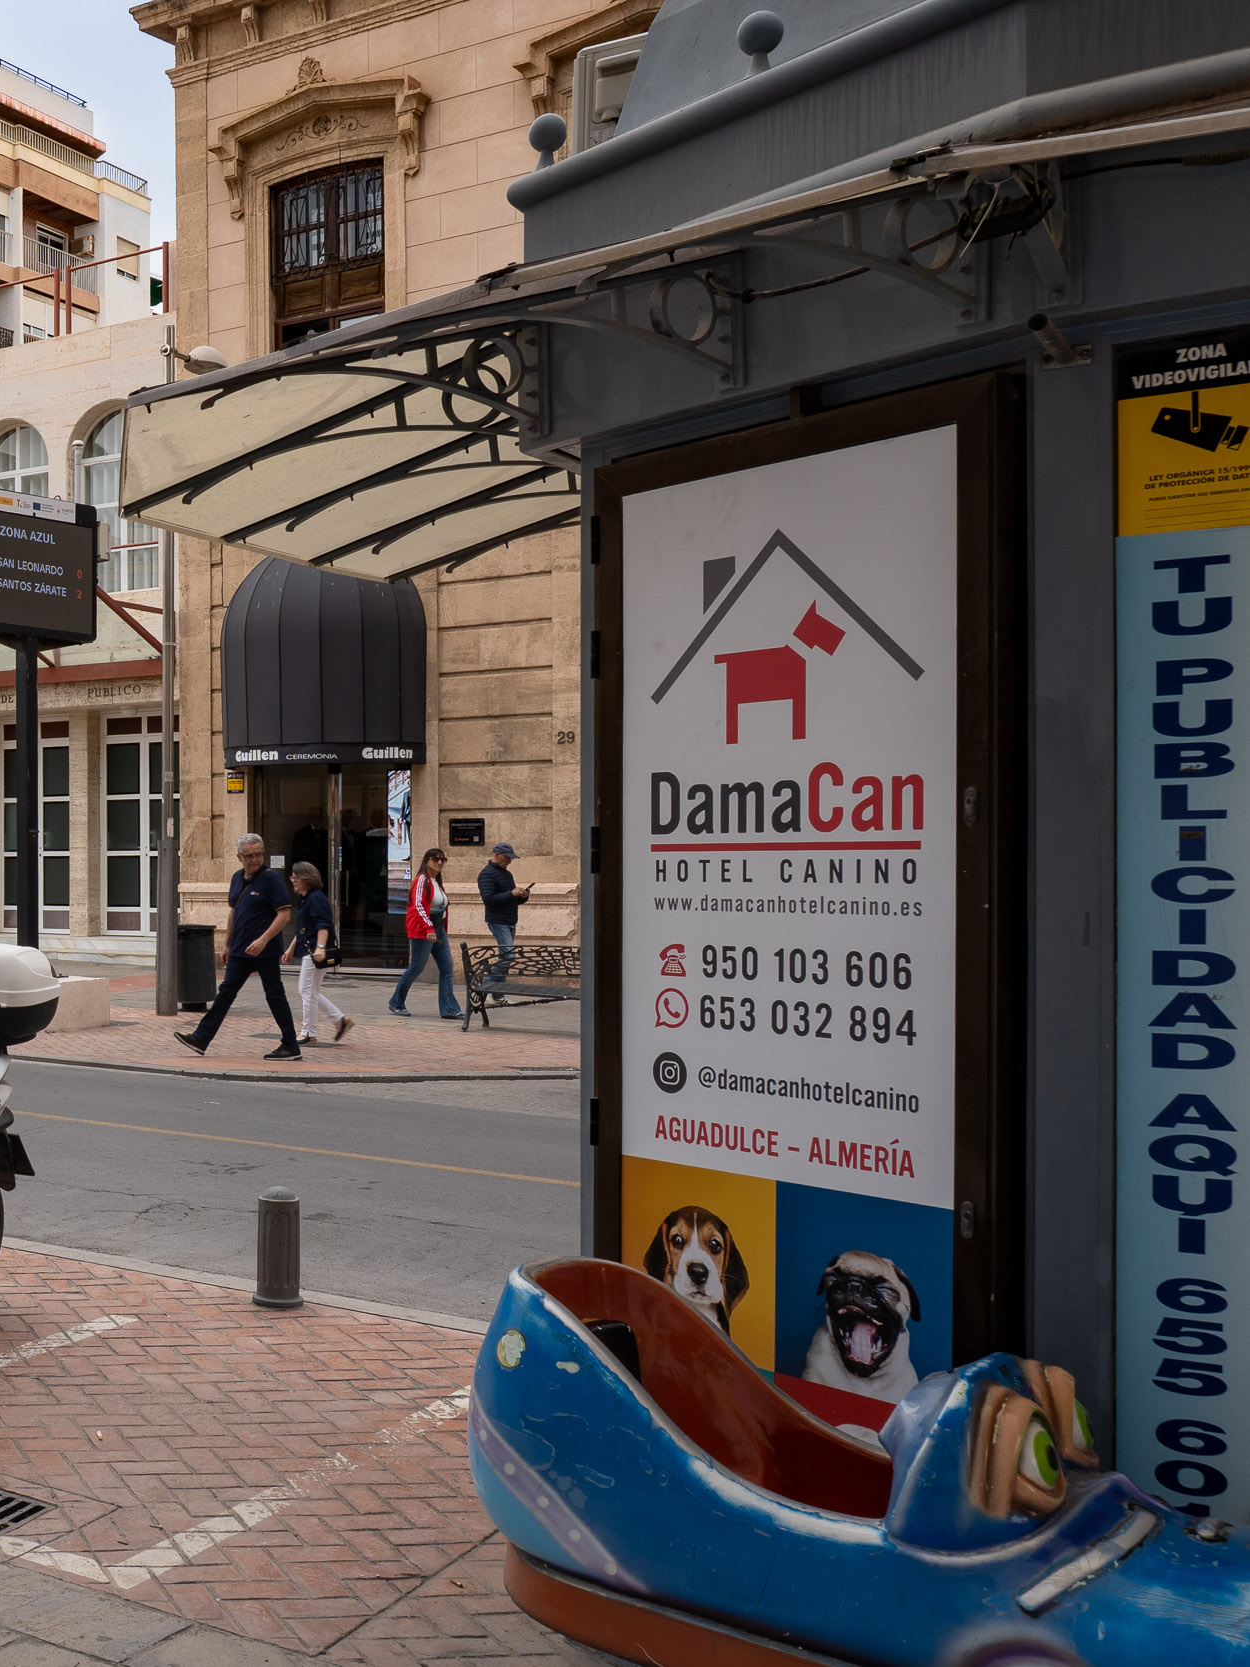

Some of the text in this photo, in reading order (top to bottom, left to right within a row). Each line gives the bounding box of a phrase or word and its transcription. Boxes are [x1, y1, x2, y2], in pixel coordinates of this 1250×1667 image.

[1175, 343, 1228, 363] ZONA
[1144, 482, 1156, 490] DE
[1158, 476, 1215, 489] PROTECCIÓN
[1218, 474, 1230, 482] DE
[1149, 474, 1164, 482] LEY
[0, 525, 28, 540] ZONA
[30, 531, 56, 545] AZUL
[17, 560, 64, 576] LEONARDO
[76, 569, 83, 579] 0
[34, 582, 67, 597] ZÁRATE
[76, 589, 83, 599] 2
[1152, 554, 1232, 636] TU
[0, 694, 15, 704] DE
[87, 684, 142, 698] PUBLICO
[557, 731, 575, 744] 29
[235, 749, 279, 763] Guillen
[285, 753, 338, 761] CEREMONIA
[362, 746, 413, 760] Guillen
[651, 761, 924, 835] DamaCan
[655, 858, 918, 885] HOTEL CANINO
[1147, 658, 1239, 1070] PUBLICIDAD
[654, 894, 923, 917] www.damacanhotelcanino.es
[701, 944, 913, 991] 950 103 606
[699, 994, 917, 1047] 653 032 894
[698, 1065, 920, 1114] @damacanhotelcanino
[654, 1114, 780, 1158] AGUADULCE
[808, 1136, 916, 1179] ALMERÍA
[1152, 1277, 1228, 1397] 655
